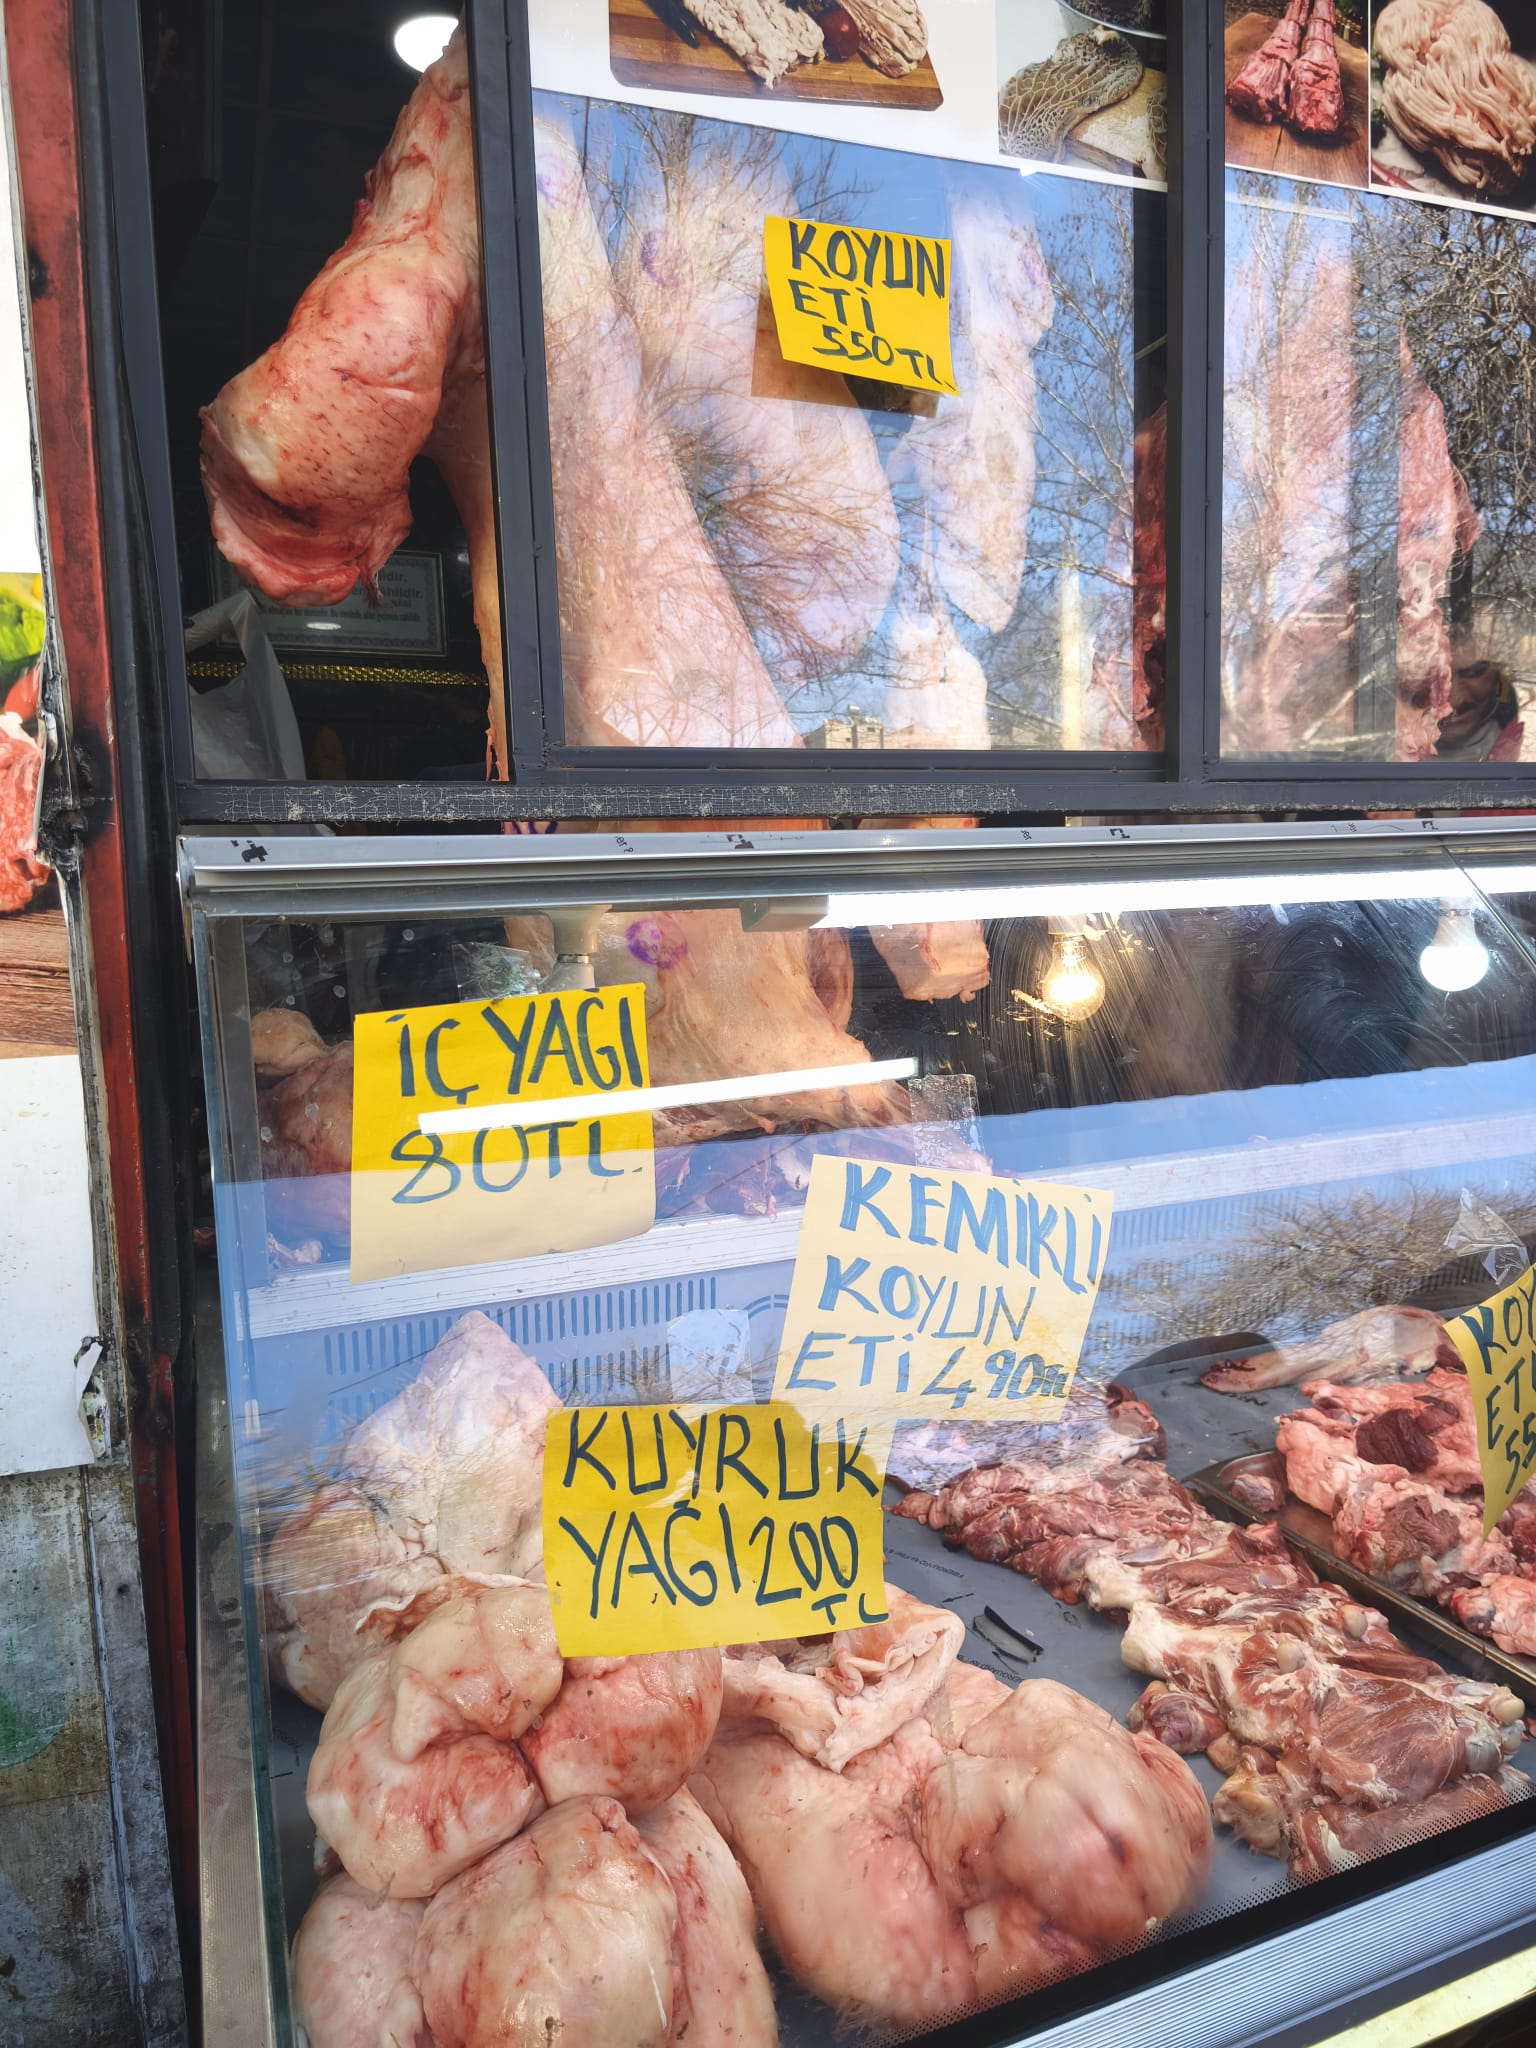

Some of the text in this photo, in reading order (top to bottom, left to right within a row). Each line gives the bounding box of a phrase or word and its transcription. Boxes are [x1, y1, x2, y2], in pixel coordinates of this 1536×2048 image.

[788, 220, 945, 299] KOYUN
[385, 1013, 479, 1104] İÇ
[840, 1161, 1101, 1295] KEMİKLİ
[818, 1255, 1037, 1345] KOYUN
[562, 1409, 880, 1500] KUYRUK
[558, 1500, 859, 1619] YAĞI 200
[811, 1593, 889, 1625] TL
